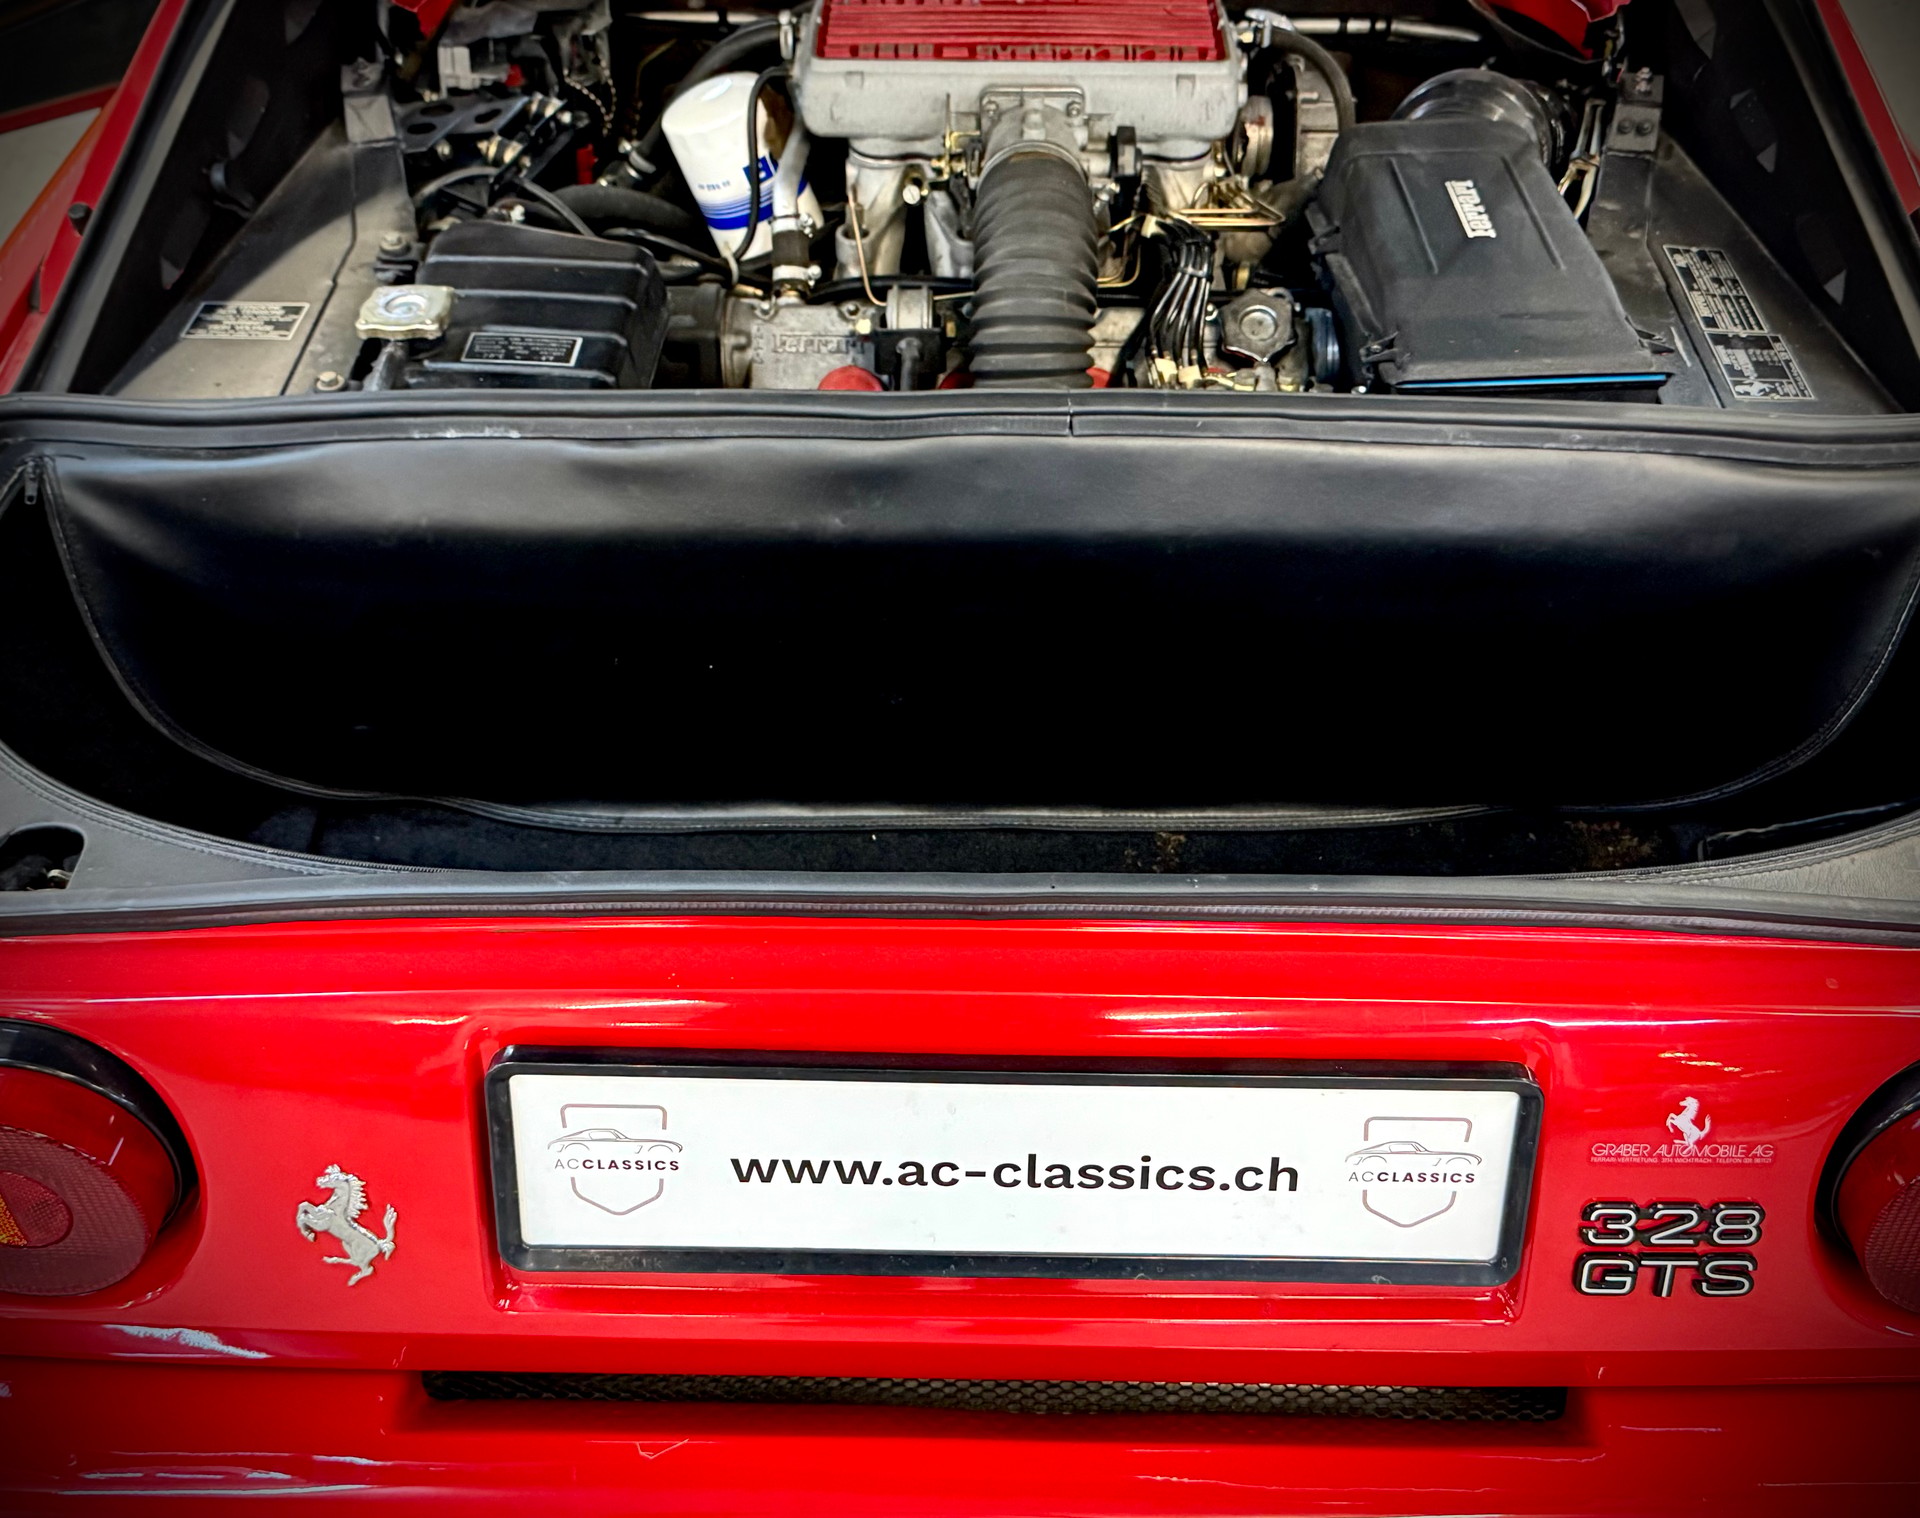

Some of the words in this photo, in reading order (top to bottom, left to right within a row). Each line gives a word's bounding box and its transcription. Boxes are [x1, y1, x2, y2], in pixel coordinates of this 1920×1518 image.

[1591, 1142, 1651, 1157] GRABER
[1652, 1144, 1747, 1158] AUTOMOBILE
[1748, 1144, 1774, 1158] AG
[730, 1153, 1299, 1192] www.ac-classics.ch
[1580, 1202, 1766, 1247] 328
[1573, 1252, 1758, 1298] GTS
